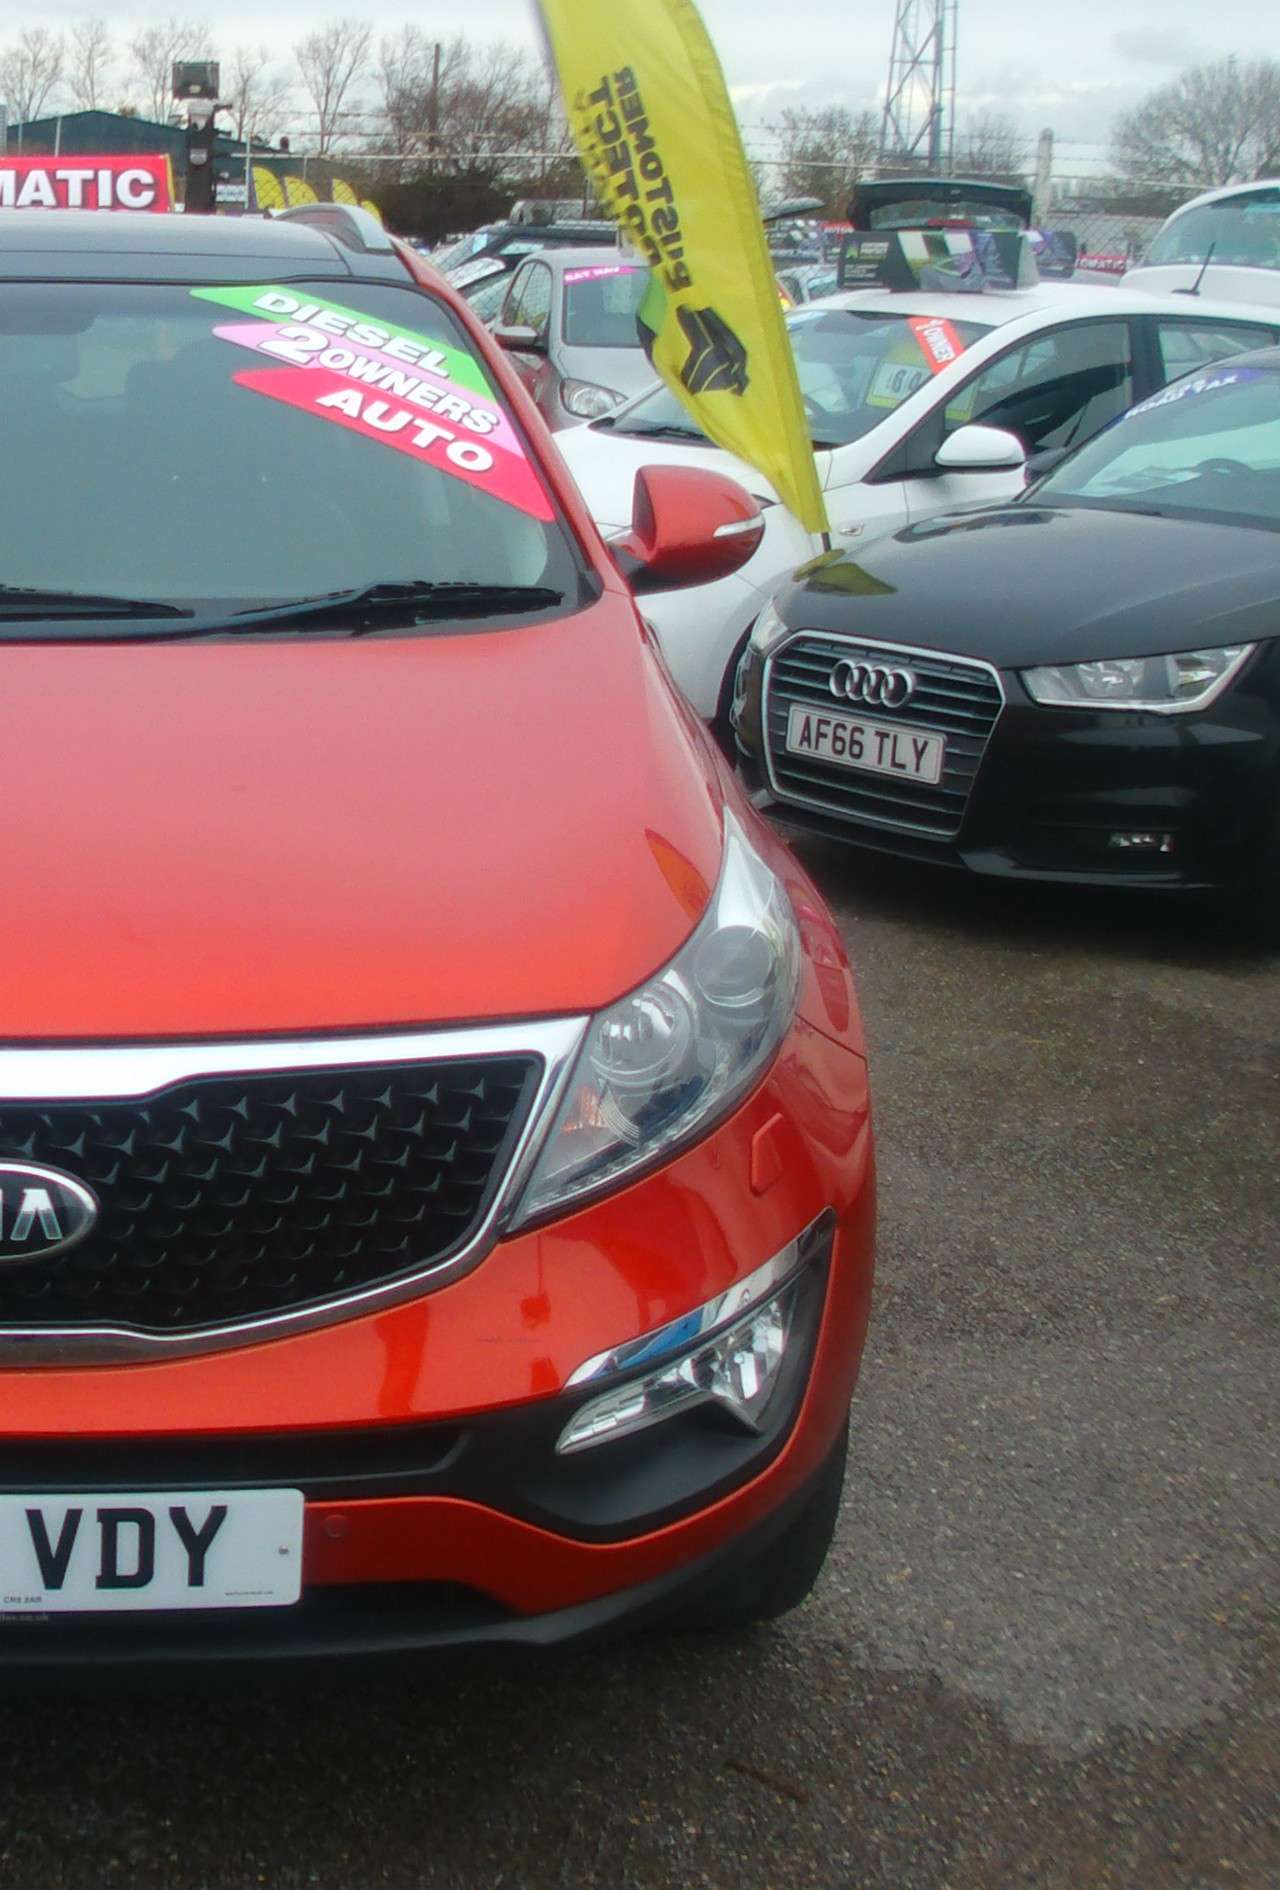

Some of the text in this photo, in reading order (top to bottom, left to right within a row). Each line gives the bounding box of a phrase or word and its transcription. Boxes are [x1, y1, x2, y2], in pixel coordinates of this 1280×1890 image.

[253, 291, 450, 379] DIESEL
[922, 326, 957, 364] OWNER
[256, 326, 501, 434] 2 OWNERS
[314, 388, 494, 473] AUTO
[798, 714, 929, 774] AF66 TLY
[25, 1504, 228, 1590] VDY
